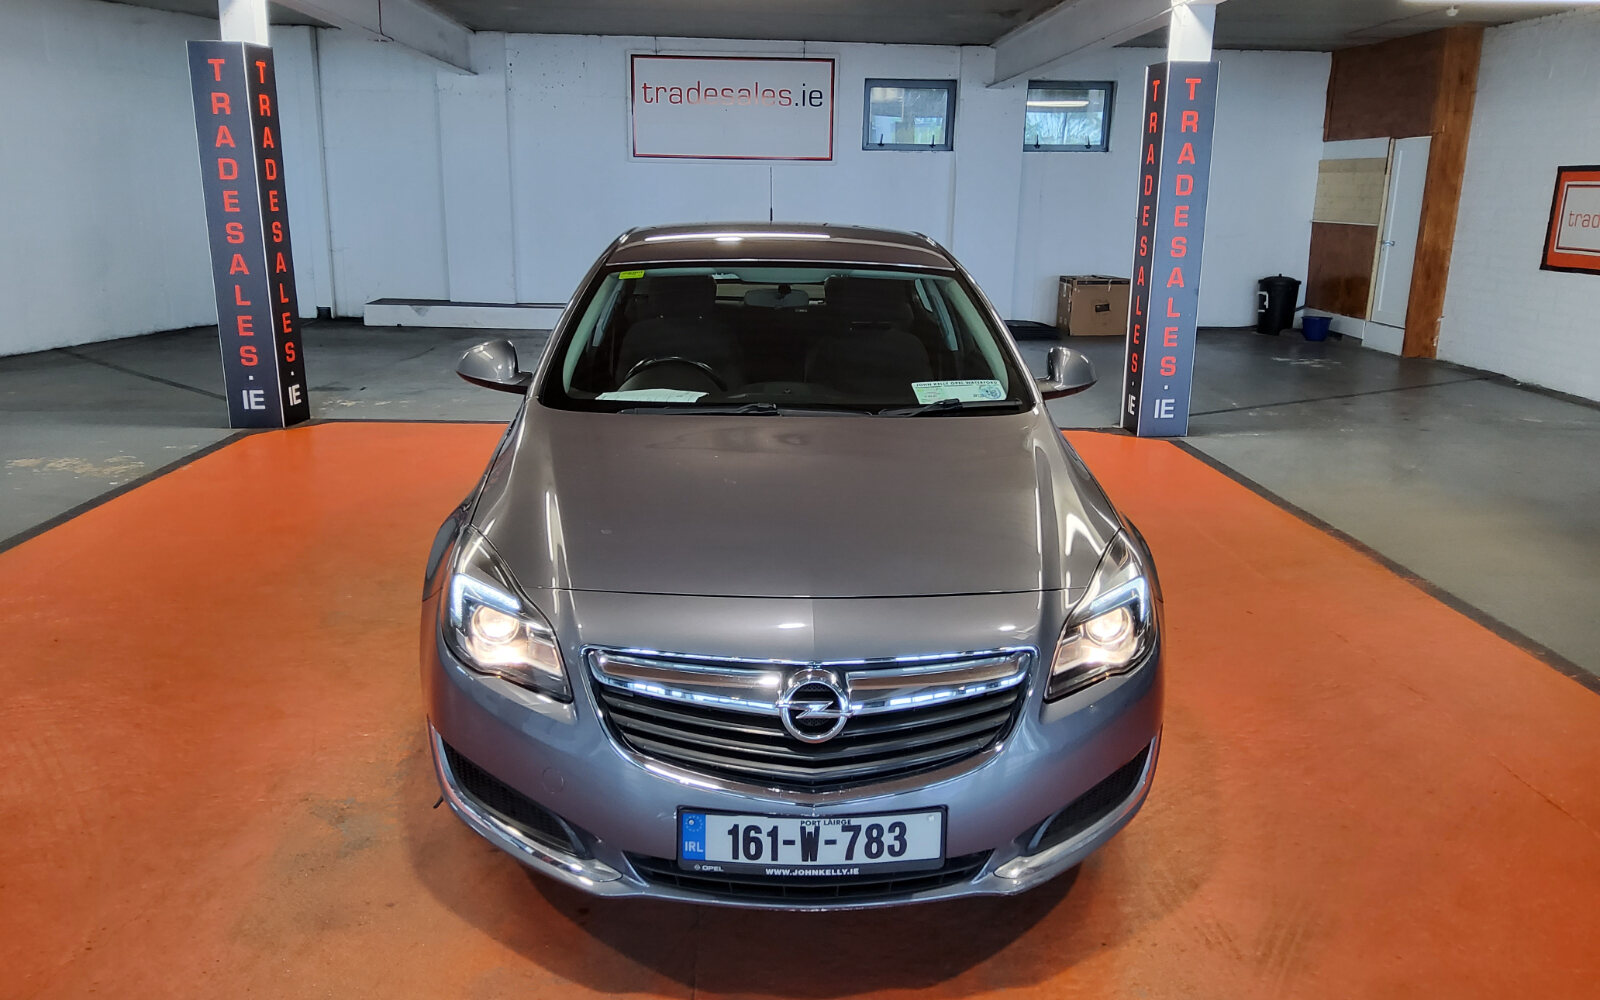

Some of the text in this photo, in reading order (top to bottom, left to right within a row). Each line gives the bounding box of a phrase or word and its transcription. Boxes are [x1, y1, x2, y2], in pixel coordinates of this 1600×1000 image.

[642, 80, 823, 107] tradesales.ie
[684, 841, 704, 853] IRL
[727, 821, 908, 863] 161-W-783
[702, 864, 724, 872] OPEL
[765, 867, 860, 877] WWW.JOHNKELLY.IE
